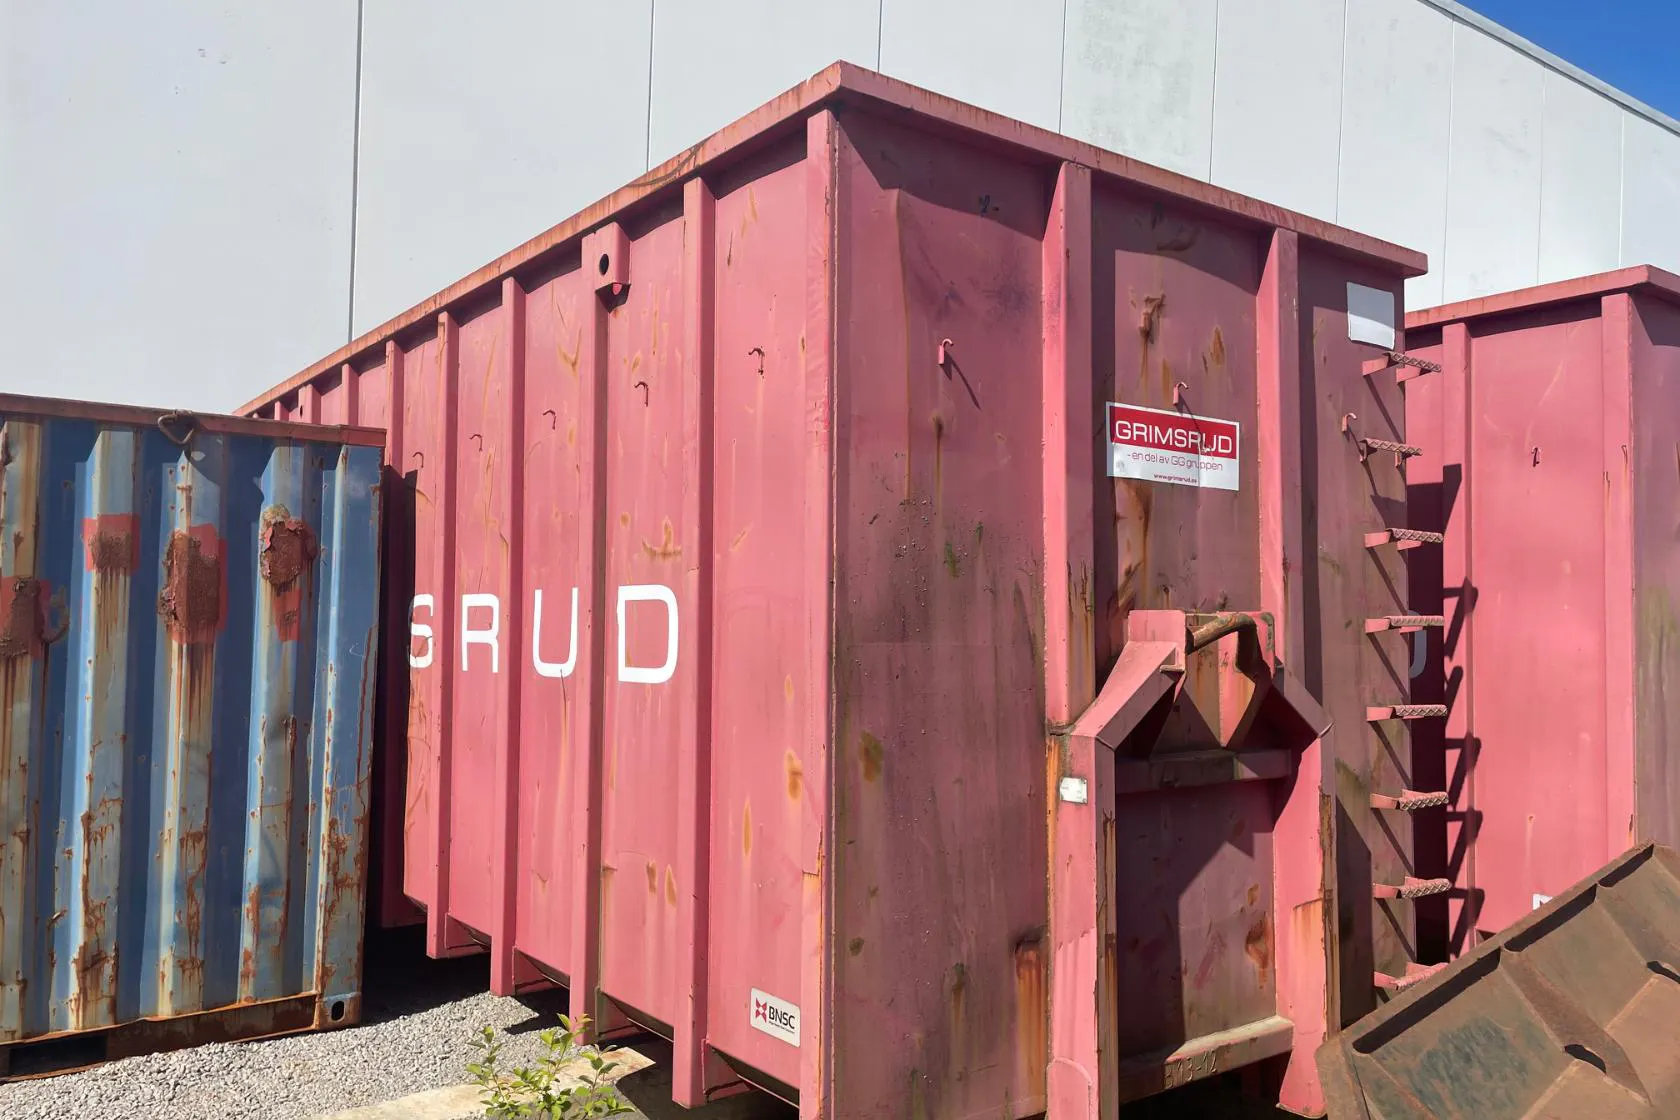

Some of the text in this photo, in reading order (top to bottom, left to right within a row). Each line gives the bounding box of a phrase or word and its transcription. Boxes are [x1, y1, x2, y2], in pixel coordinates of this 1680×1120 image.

[1115, 420, 1232, 454] GRIMSRUD
[1144, 452, 1158, 462] del
[1159, 456, 1170, 464] av
[1171, 455, 1186, 467] GG
[1186, 459, 1223, 471] gruppen
[408, 584, 679, 684] SRUD
[768, 1006, 796, 1030] BNSC
